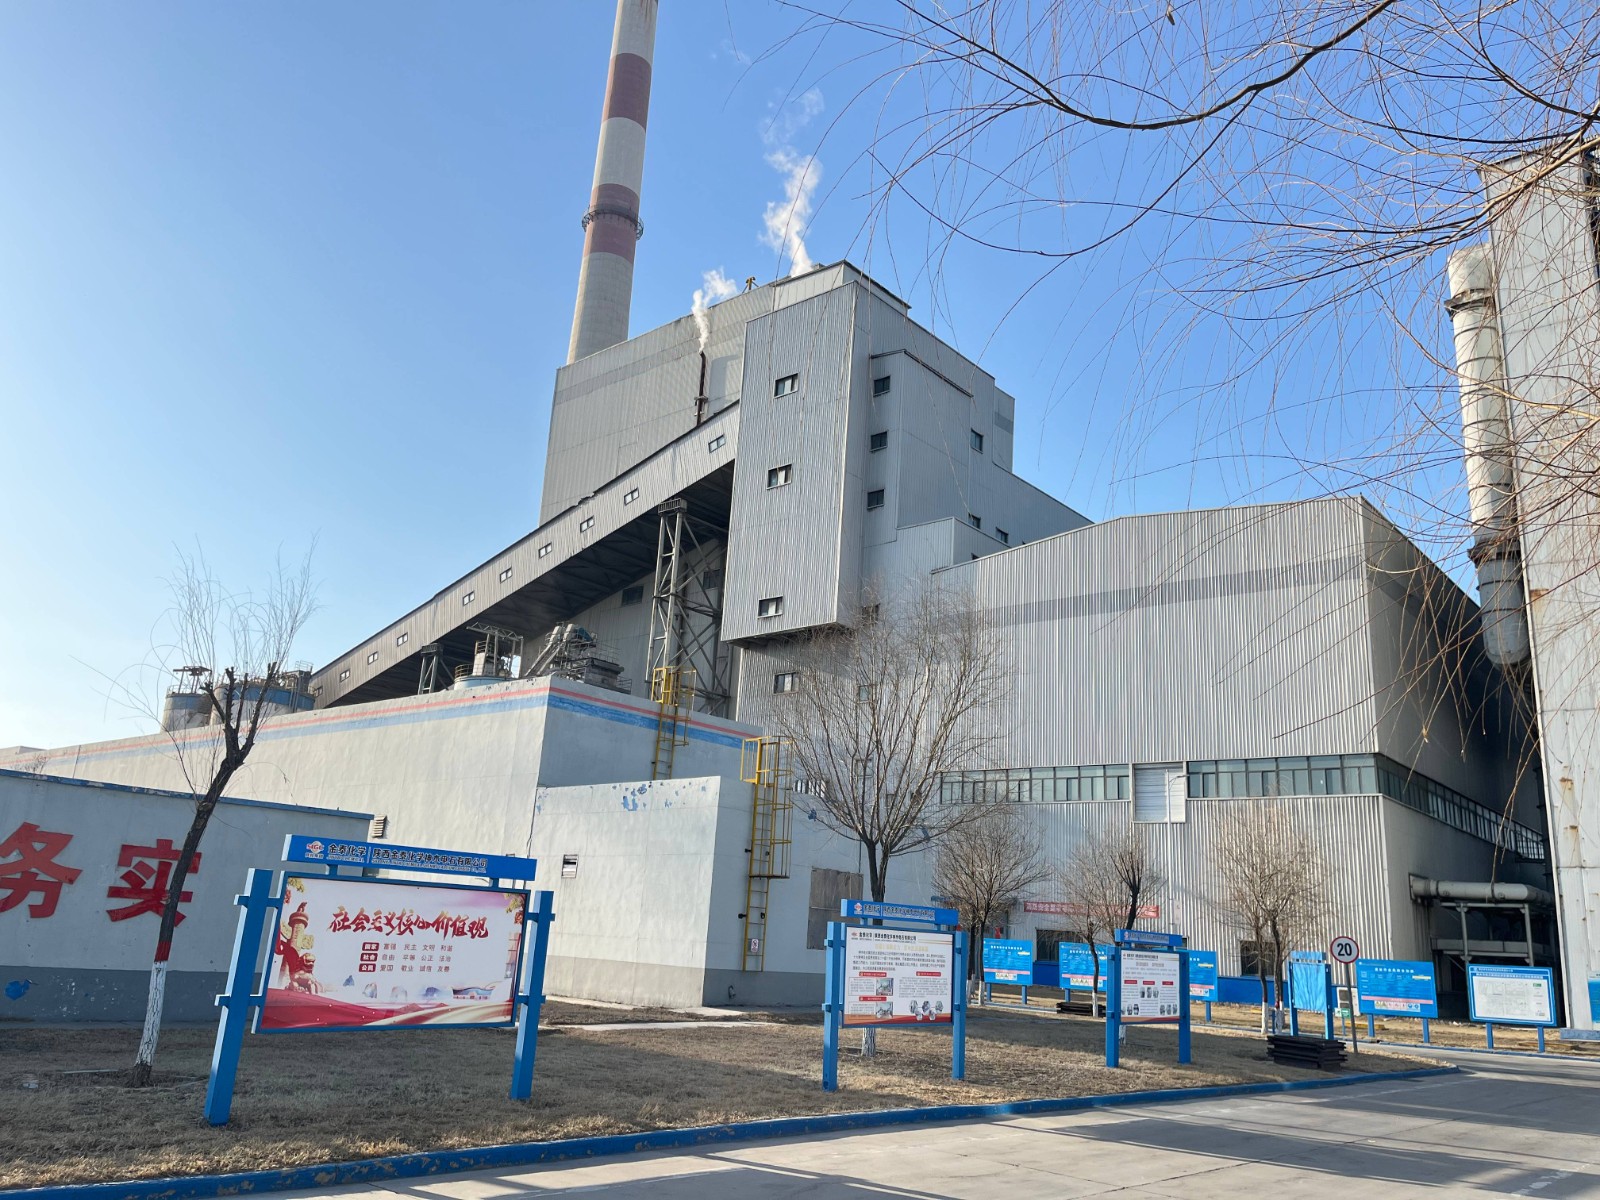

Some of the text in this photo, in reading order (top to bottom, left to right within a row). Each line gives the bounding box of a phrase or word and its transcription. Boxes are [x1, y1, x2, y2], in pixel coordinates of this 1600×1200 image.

[328, 843, 367, 857] 金泰化学
[372, 847, 489, 867] 陕西金泰化学神木电石有限公司
[0, 821, 202, 927] 务实
[328, 905, 489, 940] 社会主义核心价值观
[1337, 943, 1352, 956] 20
